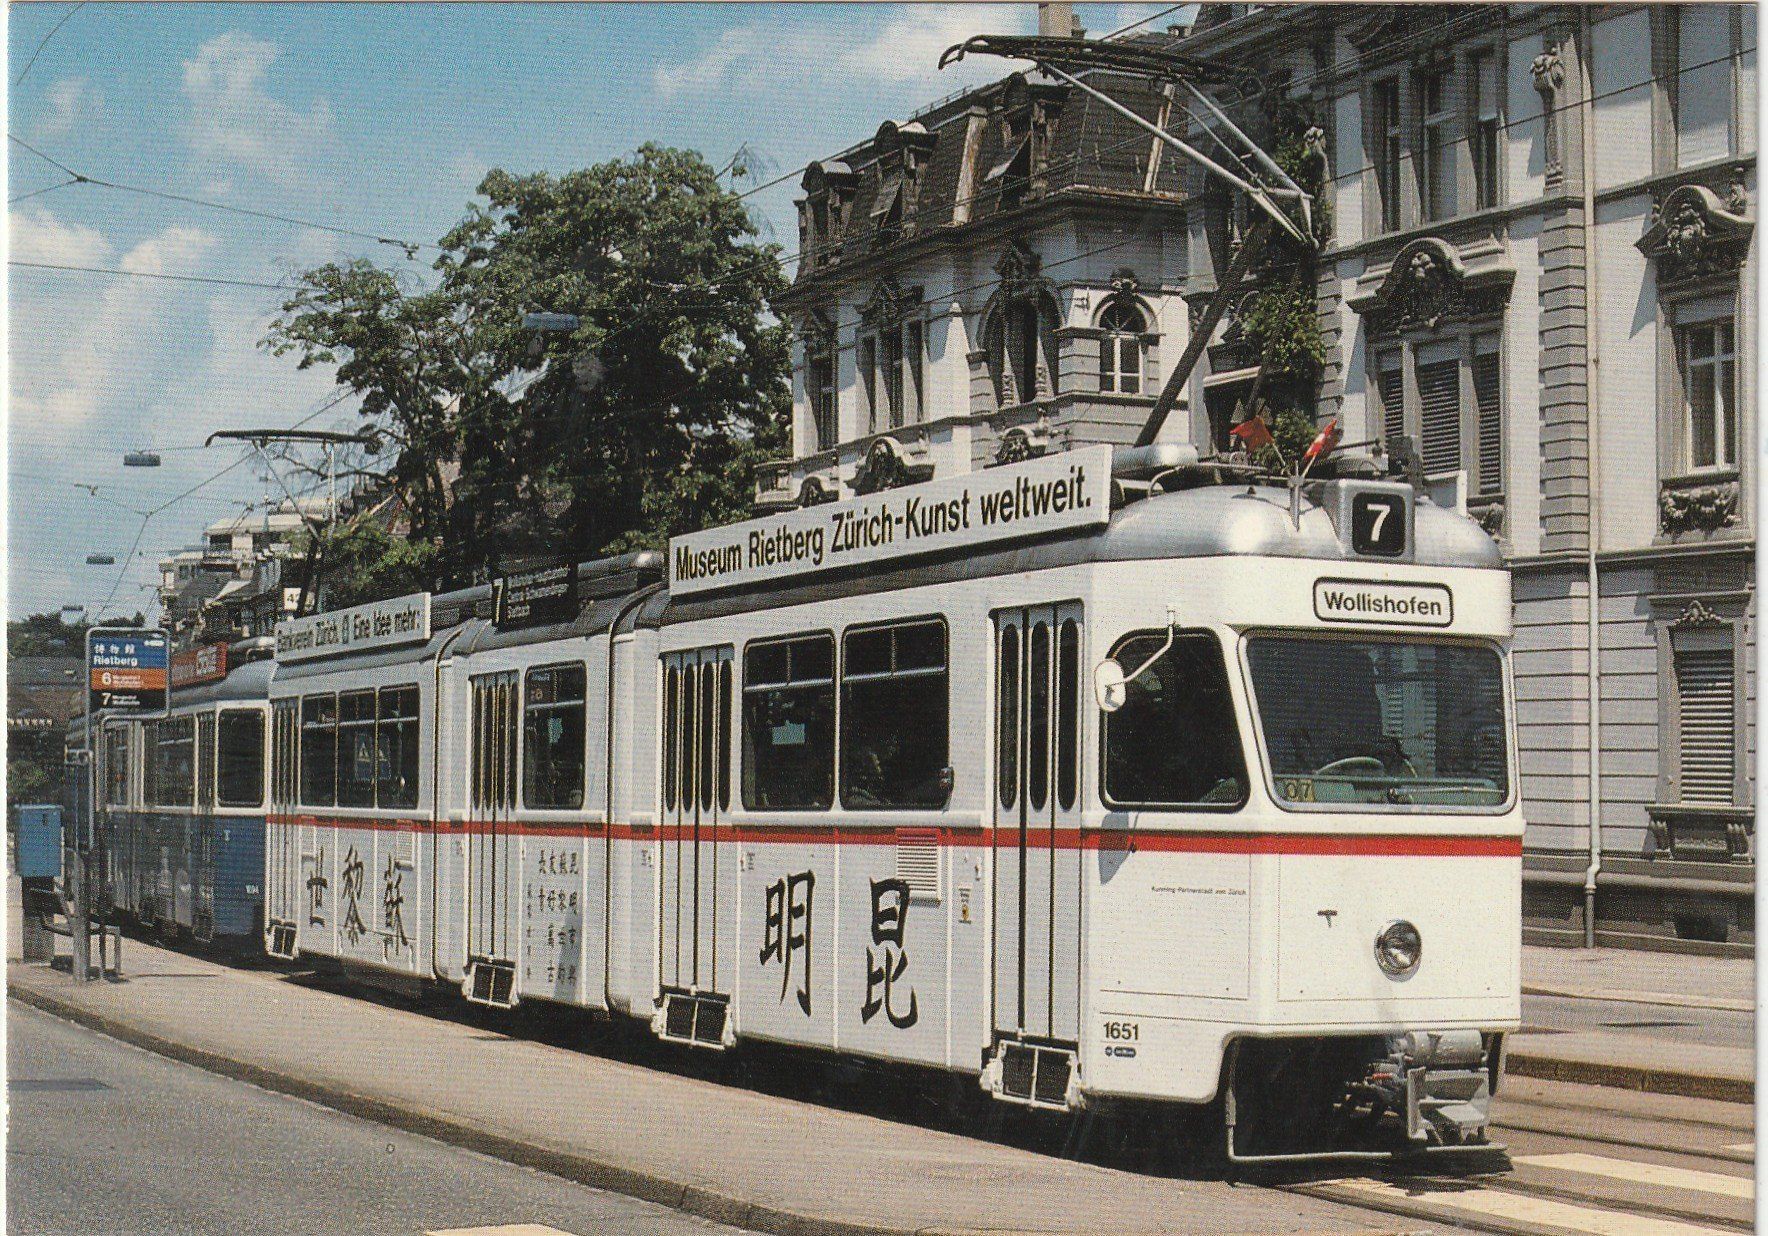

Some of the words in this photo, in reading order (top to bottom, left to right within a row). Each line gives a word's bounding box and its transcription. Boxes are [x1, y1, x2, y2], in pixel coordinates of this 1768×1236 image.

[676, 544, 742, 581] Museum
[749, 525, 824, 566] Rietberg
[831, 489, 970, 552] Zürich-Kunst
[980, 465, 1091, 526] weltweit.
[1366, 503, 1391, 542] 7
[493, 577, 504, 623] 7
[1324, 591, 1442, 616] Wollishofen
[353, 613, 371, 640] Eine
[93, 655, 138, 667] Rietberg
[102, 672, 112, 686] 6
[101, 692, 112, 706] 7
[1103, 1021, 1139, 1041] 1651
